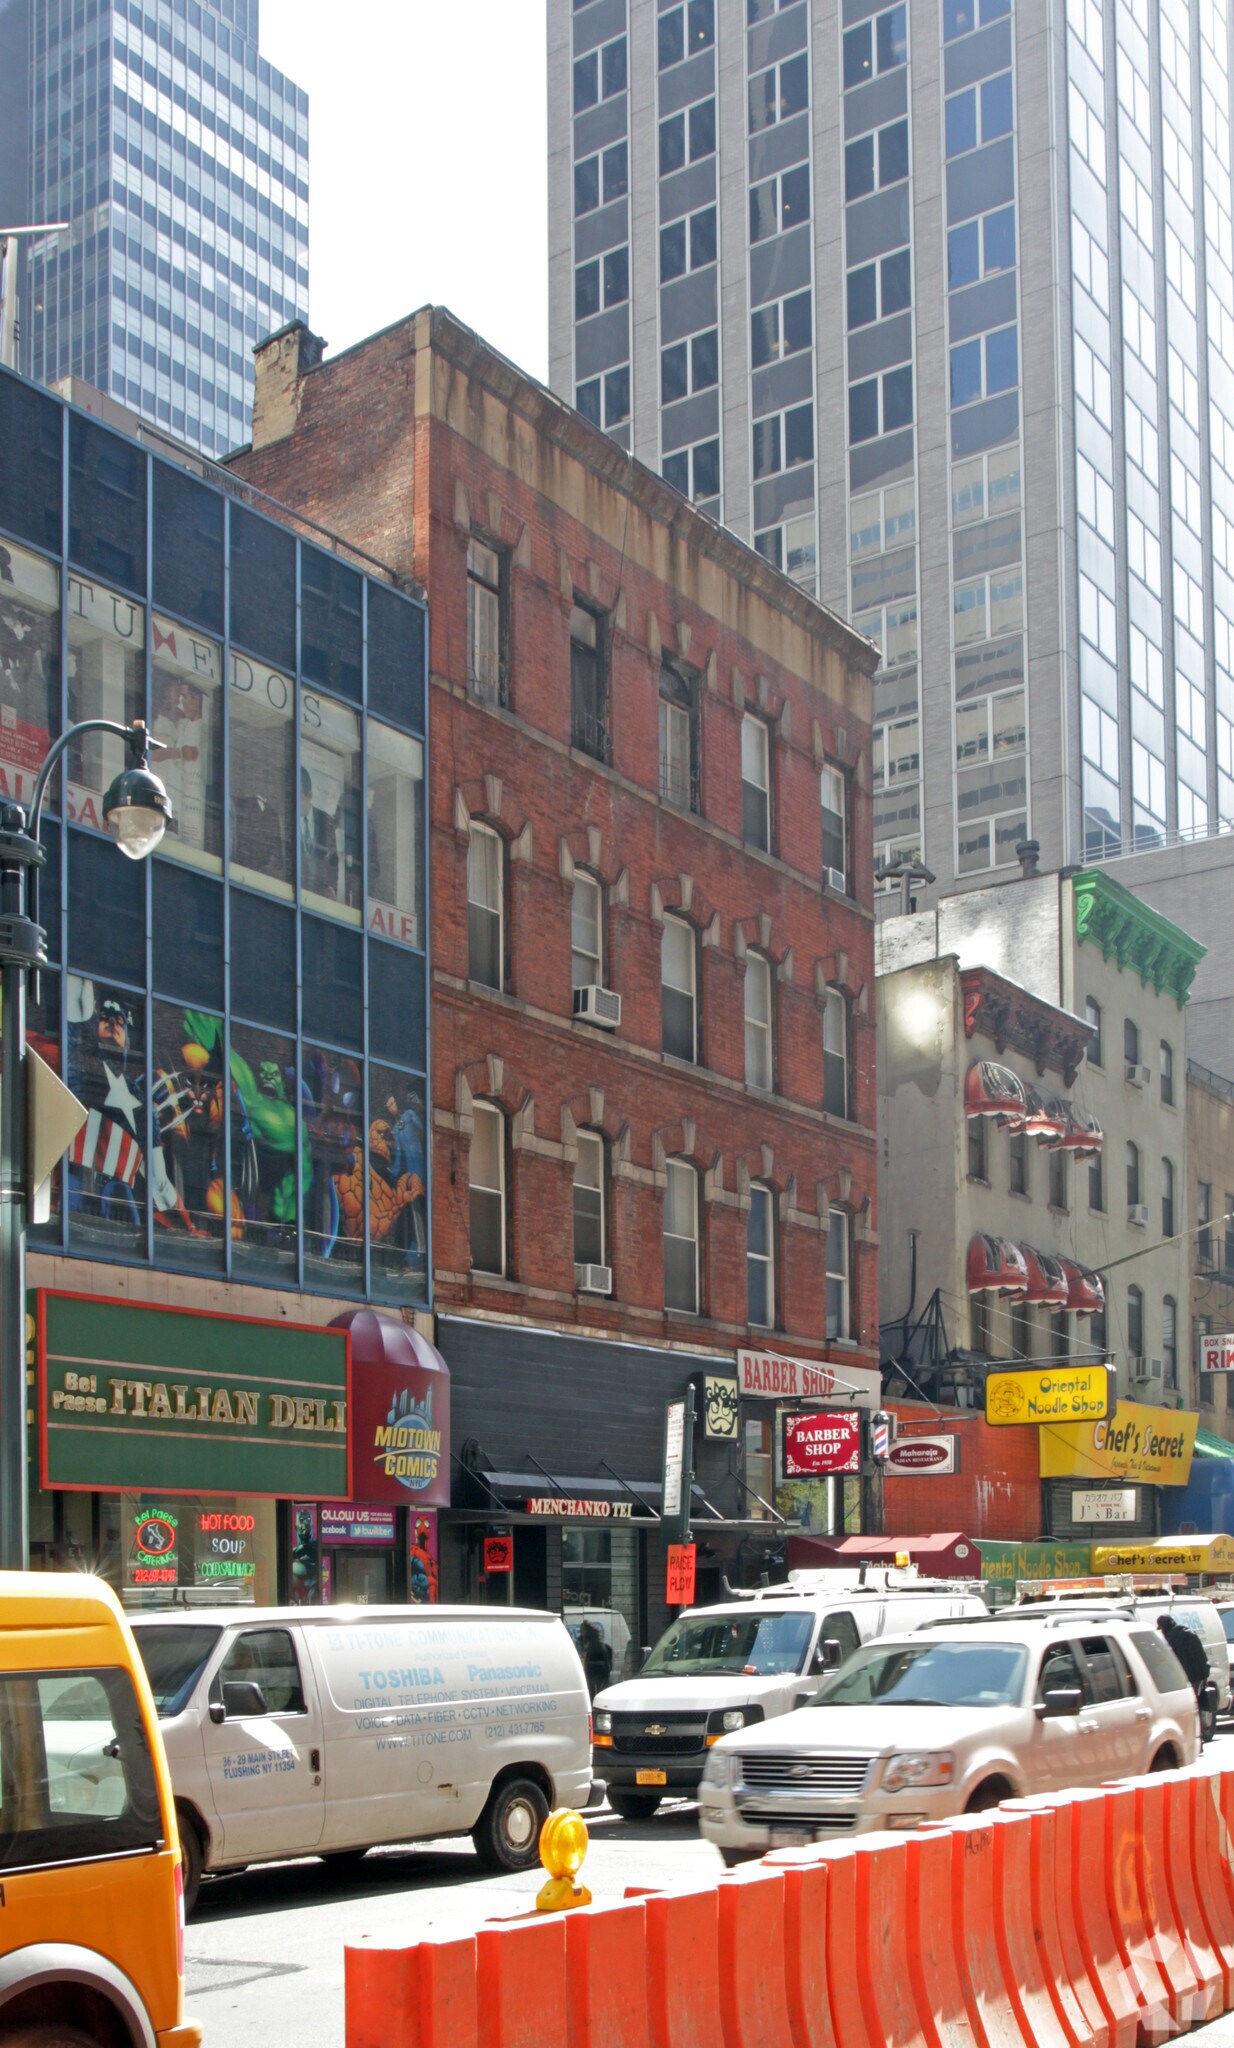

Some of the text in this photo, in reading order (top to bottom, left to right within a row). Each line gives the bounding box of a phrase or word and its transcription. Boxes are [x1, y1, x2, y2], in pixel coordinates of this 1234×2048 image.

[1203, 1338, 1219, 1347] BOX
[64, 1372, 97, 1393] Bel
[743, 1356, 835, 1399] BARBER SHOP
[1040, 1374, 1092, 1394] Oriental
[52, 1390, 107, 1414] Paese
[108, 1378, 348, 1433] ITALIAN DELI
[1028, 1396, 1068, 1418] Noodle
[1071, 1395, 1105, 1414] Shop
[374, 1425, 441, 1451] MIDTOWN
[796, 1427, 851, 1443] BARBER
[1093, 1419, 1184, 1458] Chef's Secret
[805, 1443, 842, 1456] SHOP
[900, 1448, 938, 1459] Maharaja
[384, 1455, 438, 1478] COMICS
[912, 1456, 943, 1464] RESTAURANT
[409, 1479, 423, 1488] NYC
[321, 1509, 355, 1521] OLLOW
[356, 1511, 370, 1522] US
[530, 1498, 633, 1517] MENCHANKO TEI
[1105, 1507, 1128, 1520] Bar
[134, 1508, 179, 1528] Bel Paese
[201, 1514, 255, 1531] HOT FOOD
[362, 1525, 392, 1536] twitter
[211, 1538, 246, 1554] SOUP
[137, 1550, 176, 1567] CATERING
[981, 1549, 1082, 1579] riental Noodle Shop
[1108, 1554, 1146, 1565] Chef's
[1149, 1554, 1186, 1565] Secret
[358, 1660, 543, 1690] TOSHIBA Panasonic
[354, 1683, 552, 1710] DIGITAL TELEPHONE SYSTEM VOICEMAIL
[354, 1699, 558, 1731] VOICE DATA FIBER CCTV NETWORKING
[508, 1721, 545, 1735] 431-7765
[237, 1753, 246, 1765] 29
[247, 1751, 266, 1764] MAIN
[224, 1760, 296, 1779] FLUSHING NY 11354
